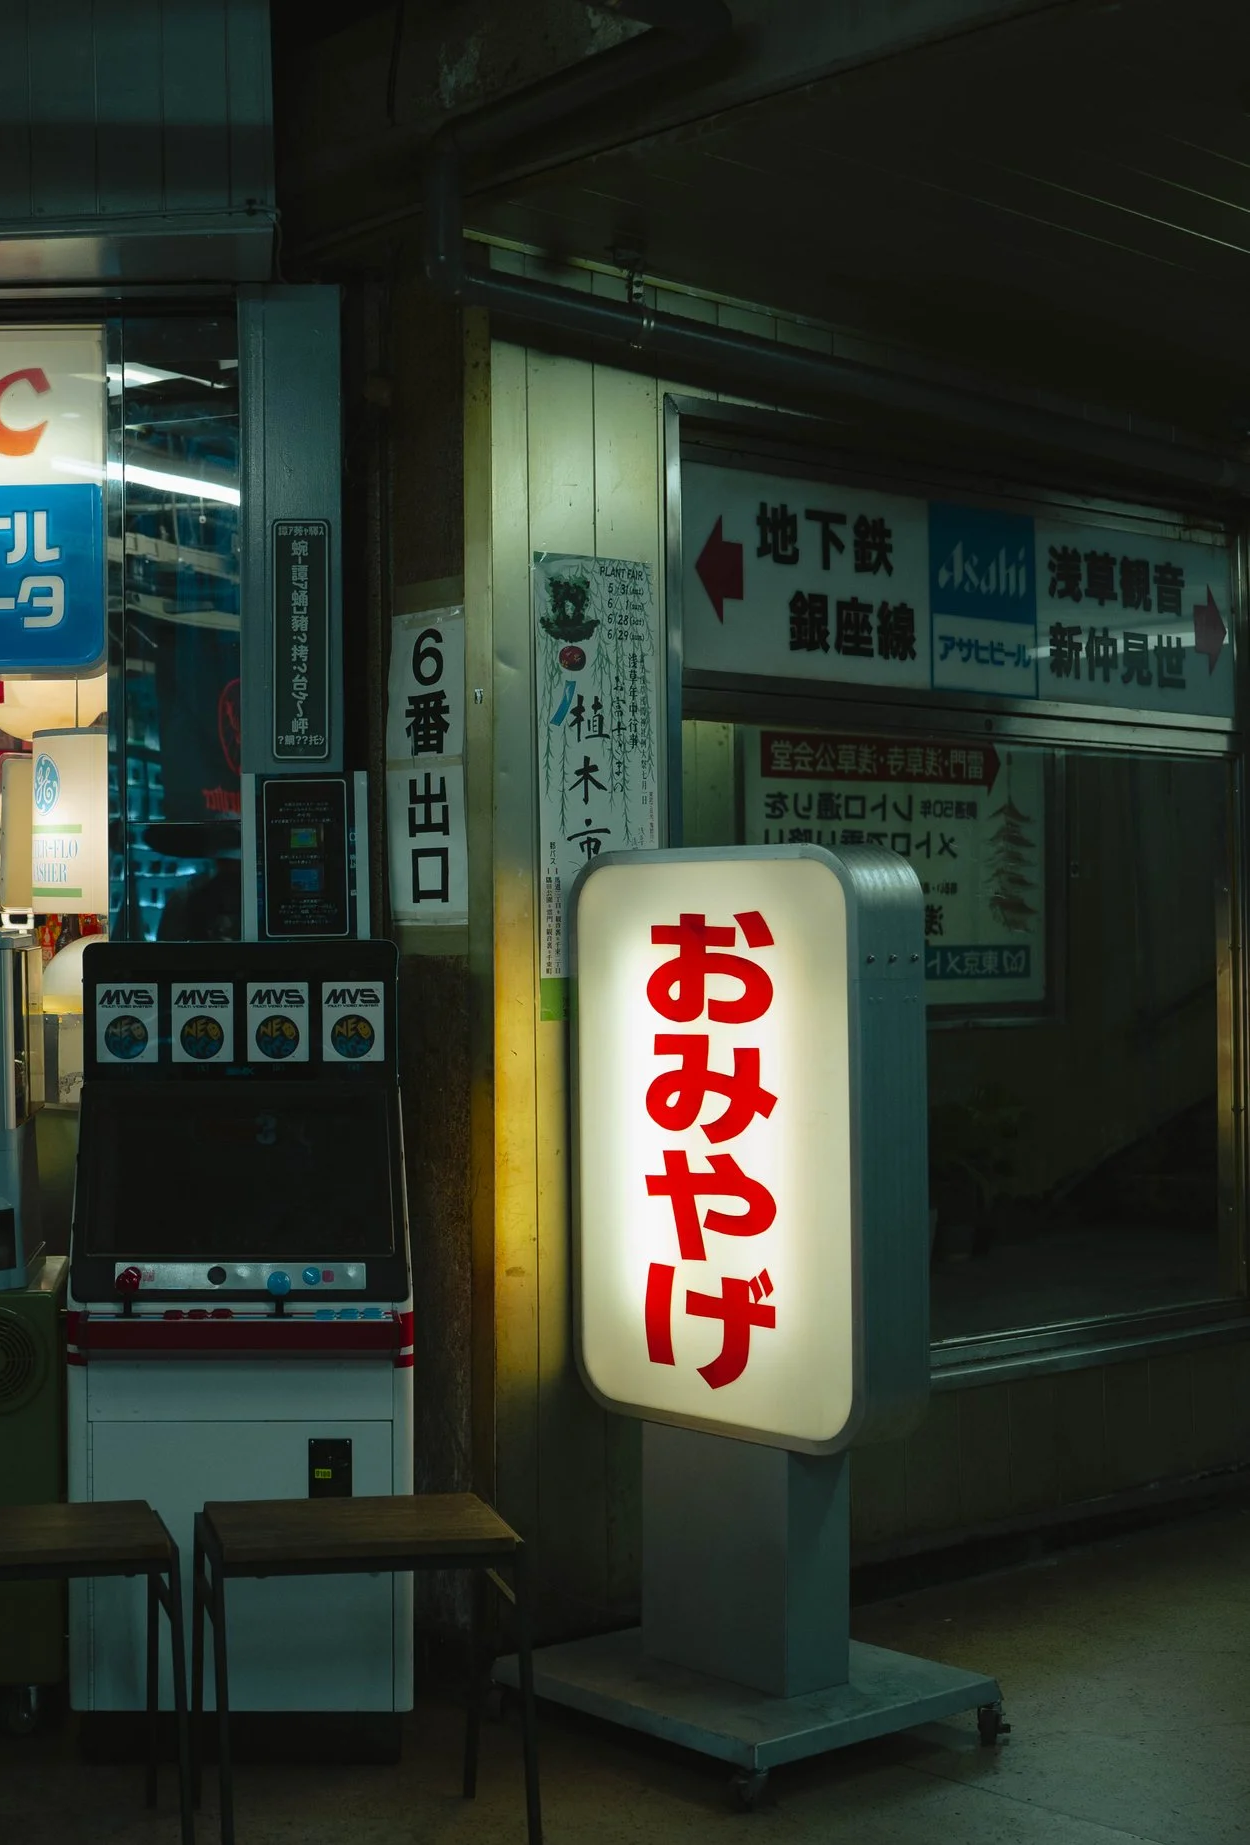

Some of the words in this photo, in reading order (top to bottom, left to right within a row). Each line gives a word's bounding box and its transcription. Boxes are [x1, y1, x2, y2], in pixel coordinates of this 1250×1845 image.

[756, 501, 893, 577] 地下鉄
[937, 536, 1027, 599] Asahi
[1048, 545, 1185, 617] 浅草観音
[788, 590, 917, 662] 銀座線
[938, 633, 1032, 669] アサヒビール
[1048, 622, 1187, 691] 新仲見世
[405, 628, 450, 904] 6番出口
[567, 694, 611, 861] 植木市
[99, 989, 154, 1004] MVS
[174, 989, 230, 1004] MVS
[250, 989, 305, 1004] MVS
[325, 989, 380, 1004] MVS
[645, 911, 777, 1389] おみやげ
